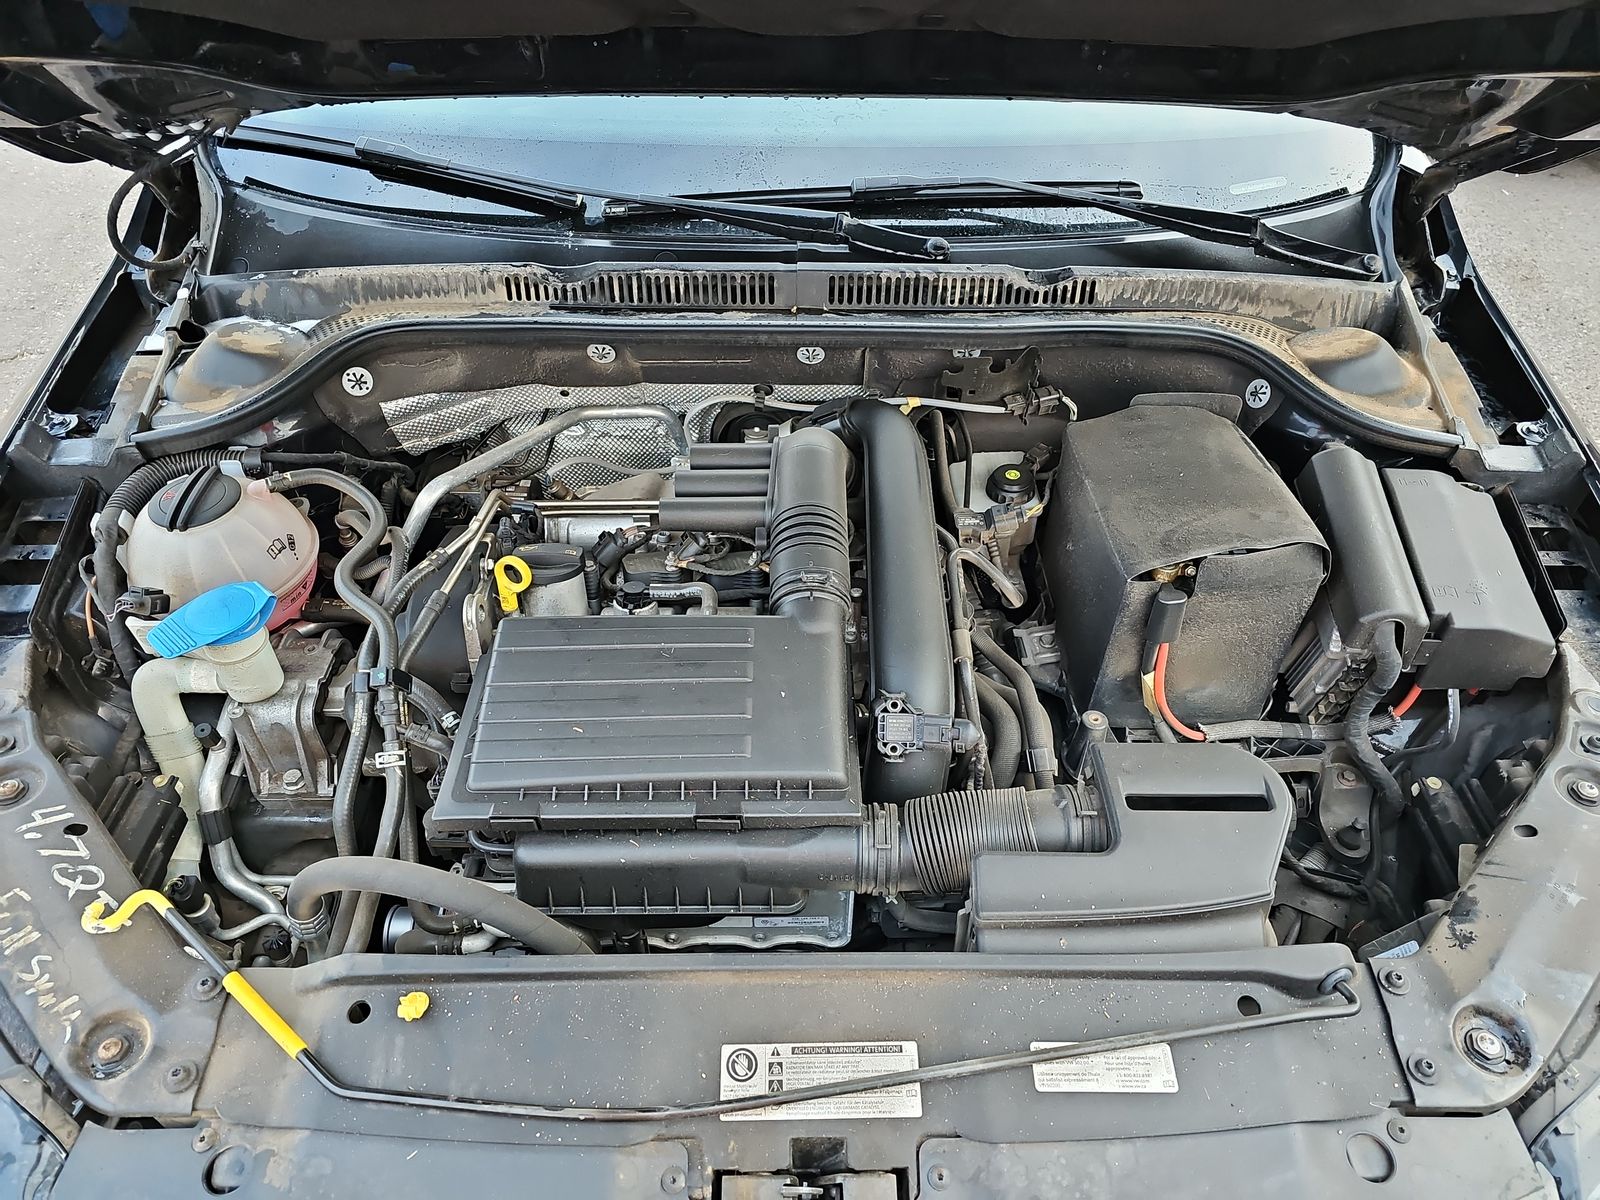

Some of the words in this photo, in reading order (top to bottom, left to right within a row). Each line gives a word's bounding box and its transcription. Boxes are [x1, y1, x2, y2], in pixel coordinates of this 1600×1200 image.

[290, 591, 302, 604] min
[793, 1046, 829, 1055] ACHTUNG!
[829, 1046, 863, 1054] WARNING!
[863, 1045, 902, 1054] ATTENTION!
